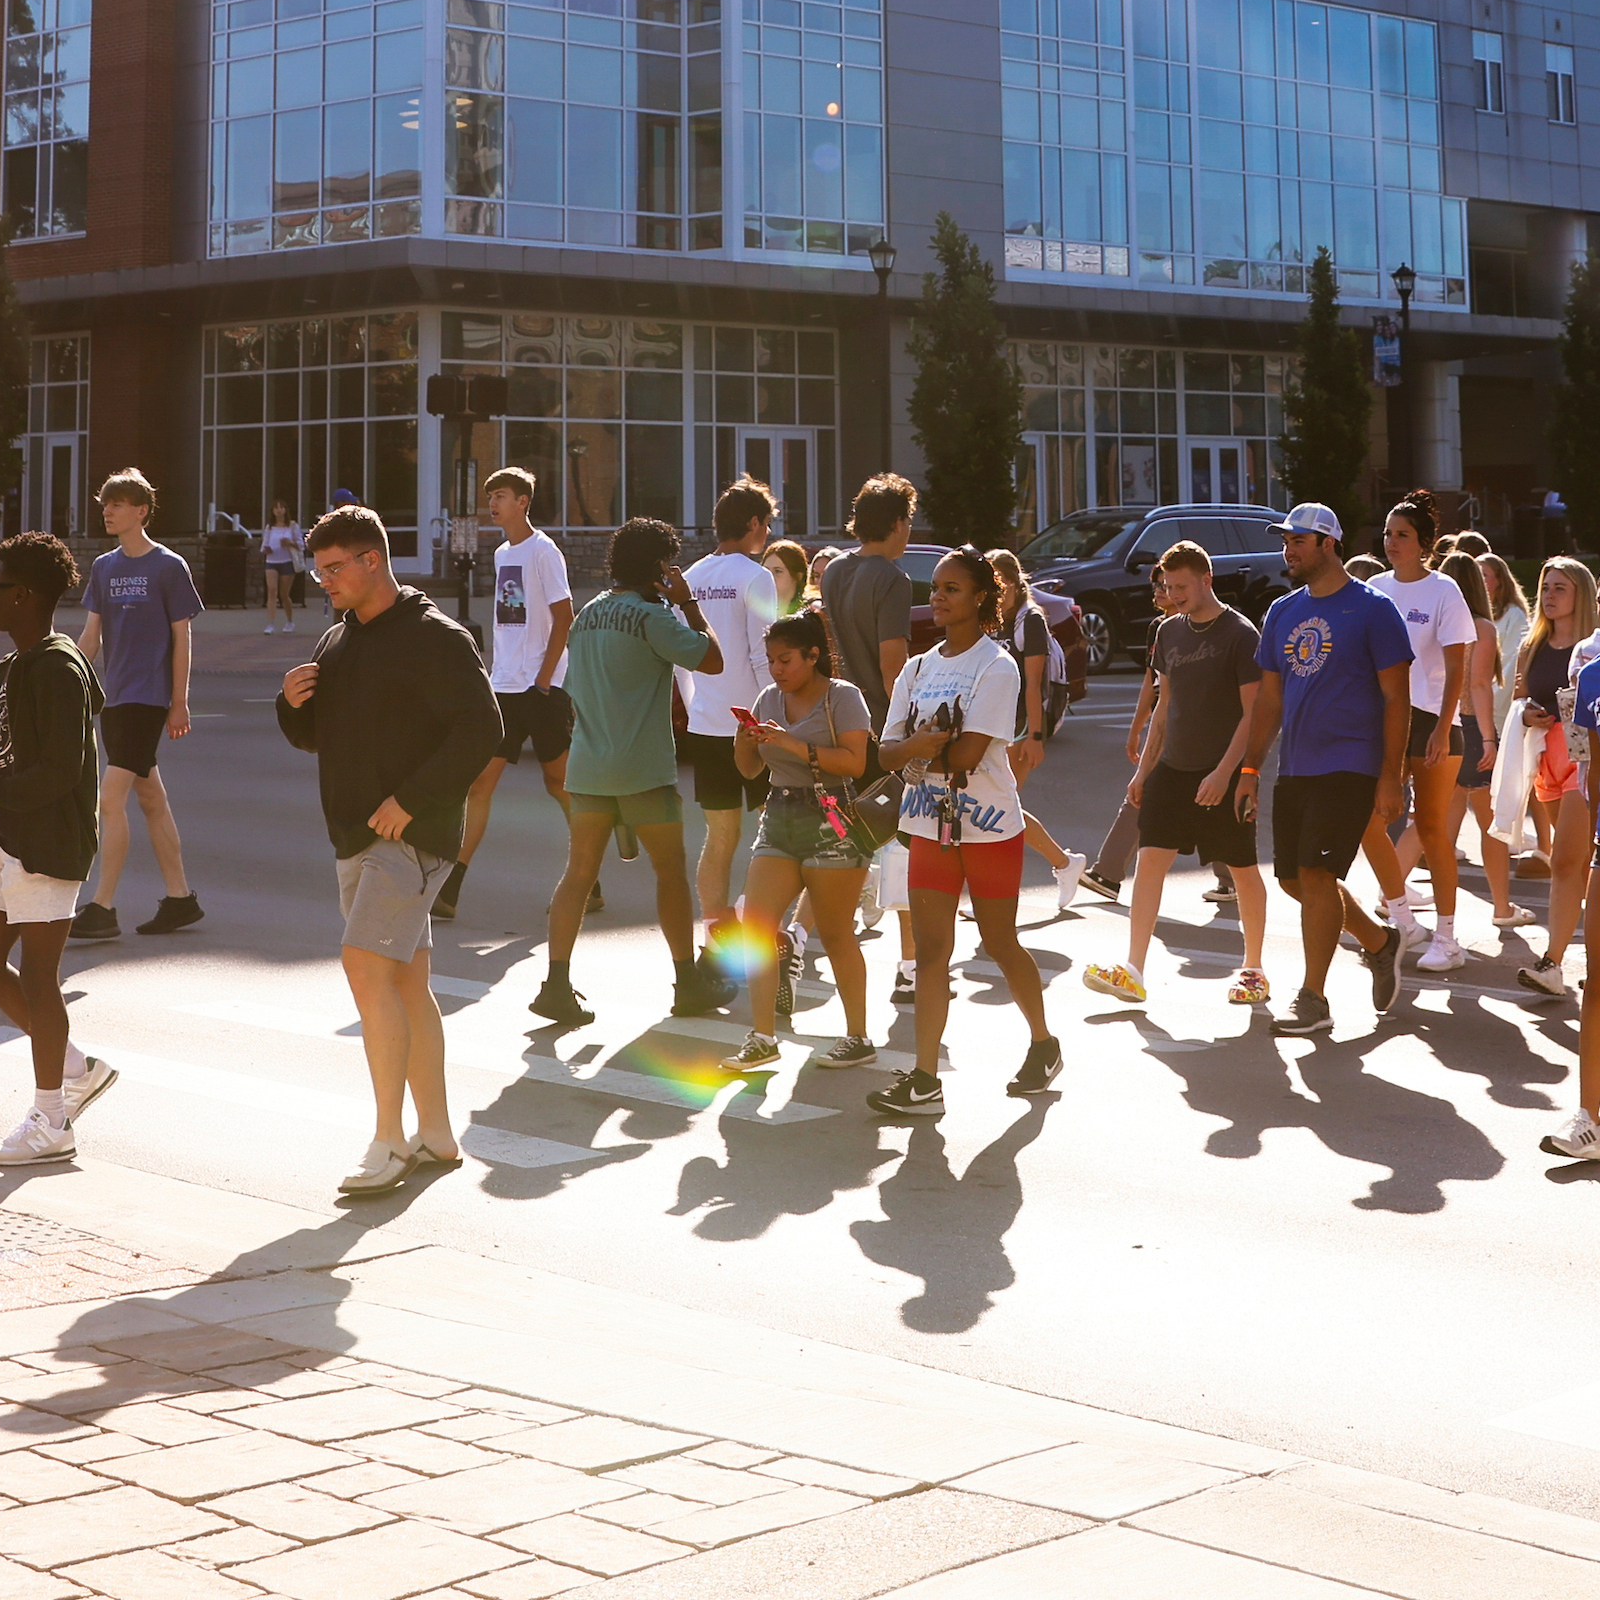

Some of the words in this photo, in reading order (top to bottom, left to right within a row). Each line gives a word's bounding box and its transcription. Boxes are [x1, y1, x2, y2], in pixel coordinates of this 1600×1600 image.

[110, 577, 148, 587] BUSINESS
[1165, 641, 1218, 676] Fender
[1286, 653, 1328, 678] FOOTBALL
